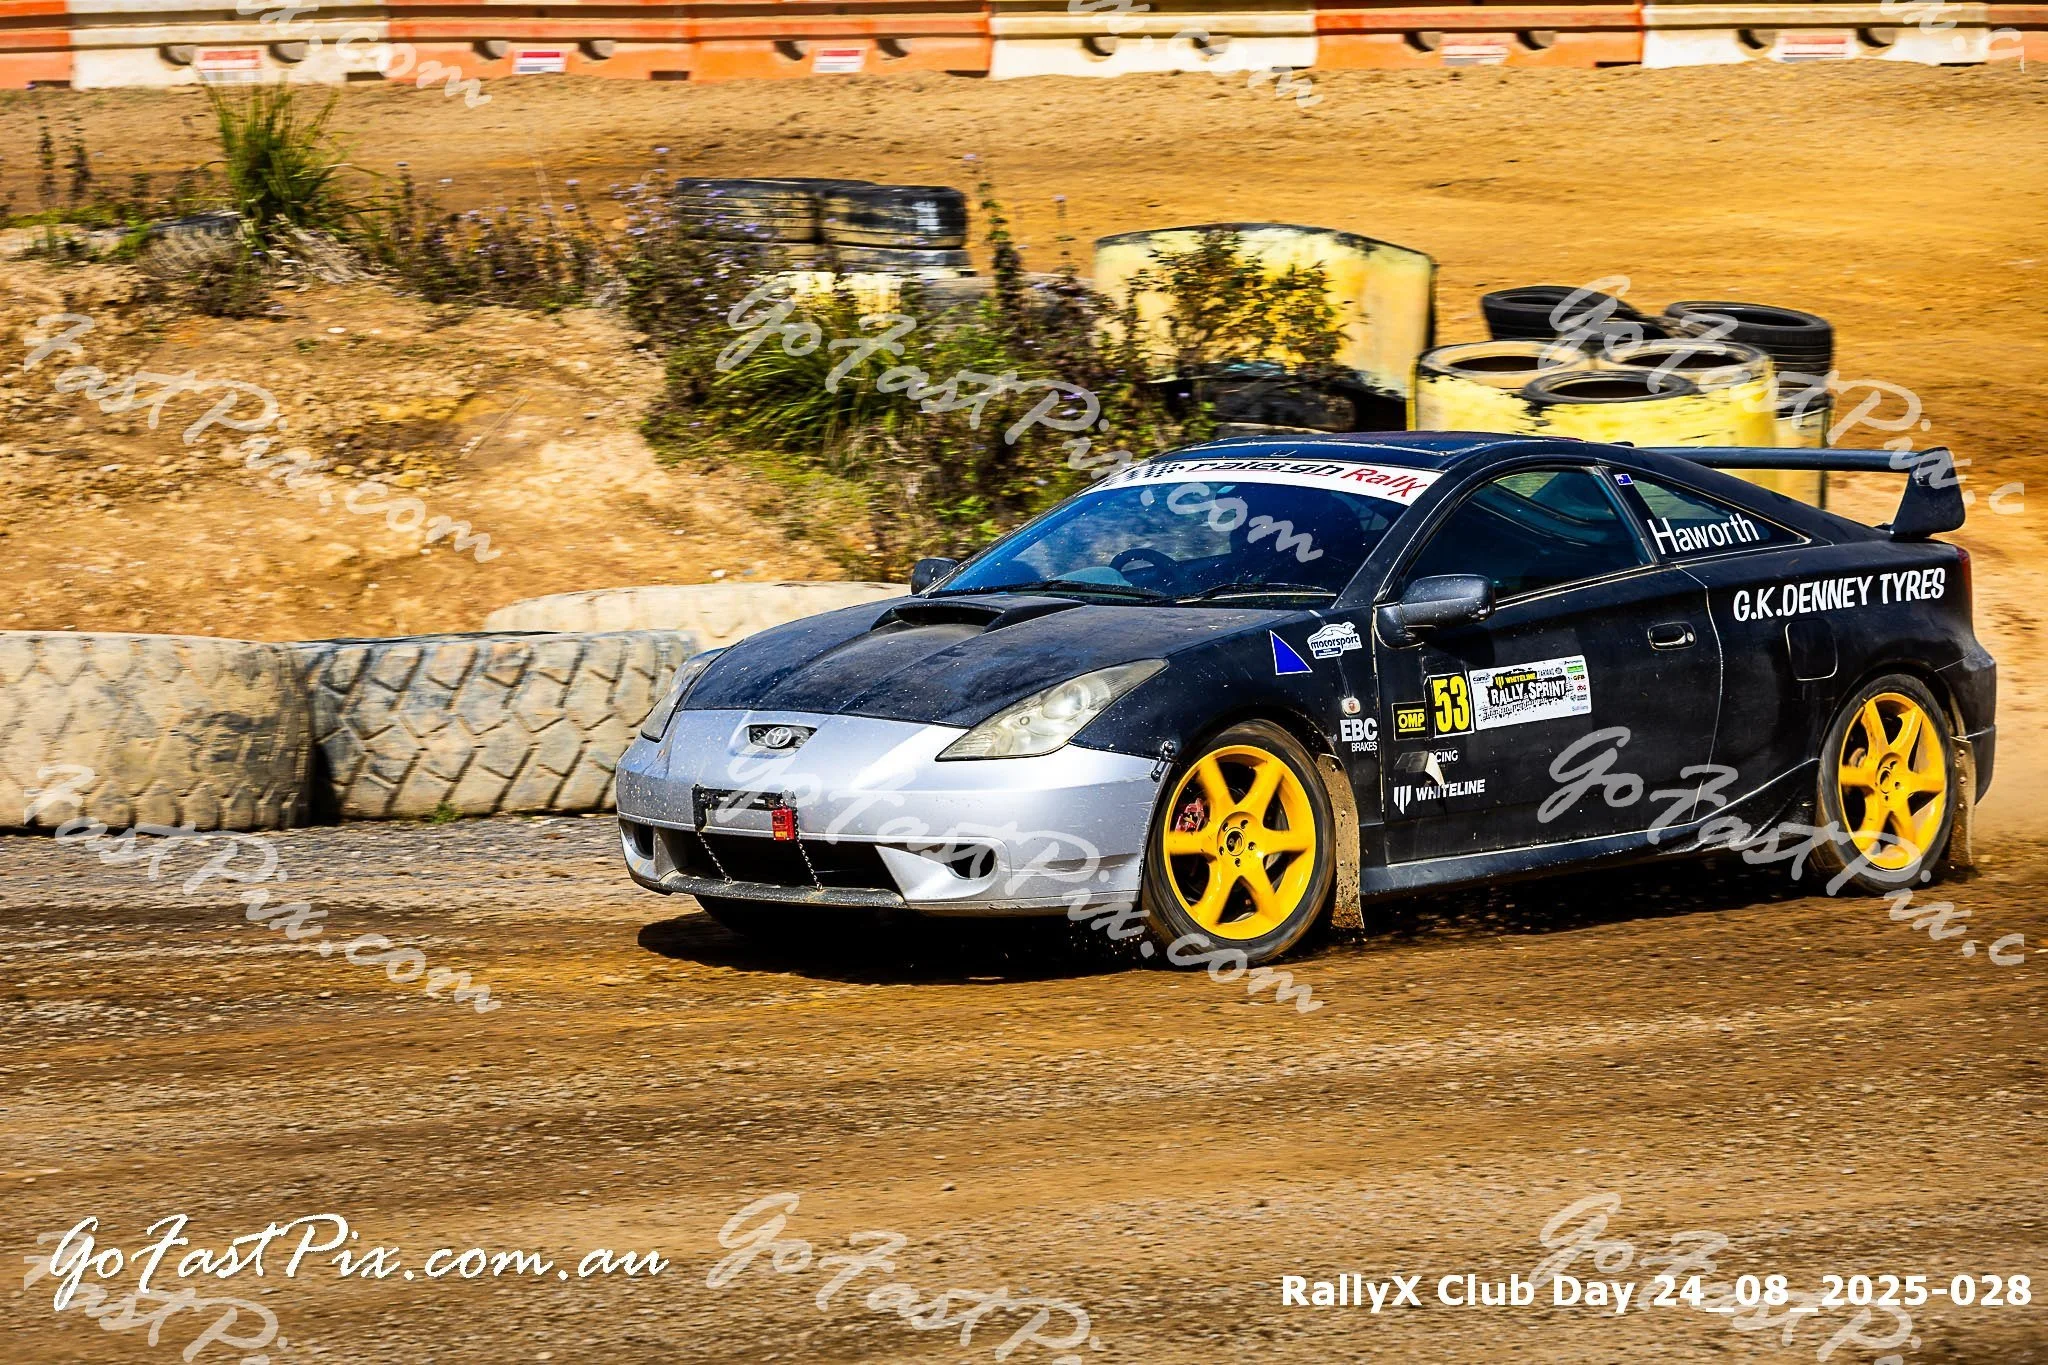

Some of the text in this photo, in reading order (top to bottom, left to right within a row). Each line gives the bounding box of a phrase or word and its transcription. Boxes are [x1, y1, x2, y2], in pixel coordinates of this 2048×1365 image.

[1647, 515, 1759, 555] Haworth
[1733, 567, 1946, 622] G.K.DENNEY TYRES
[1432, 675, 1470, 732] 53
[1491, 680, 1566, 706] RALLY SPRINT
[1340, 718, 1378, 742] EBC
[1398, 713, 1425, 729] OMP
[1351, 741, 1378, 752] BRAKES
[1416, 779, 1486, 800] WHITELINE
